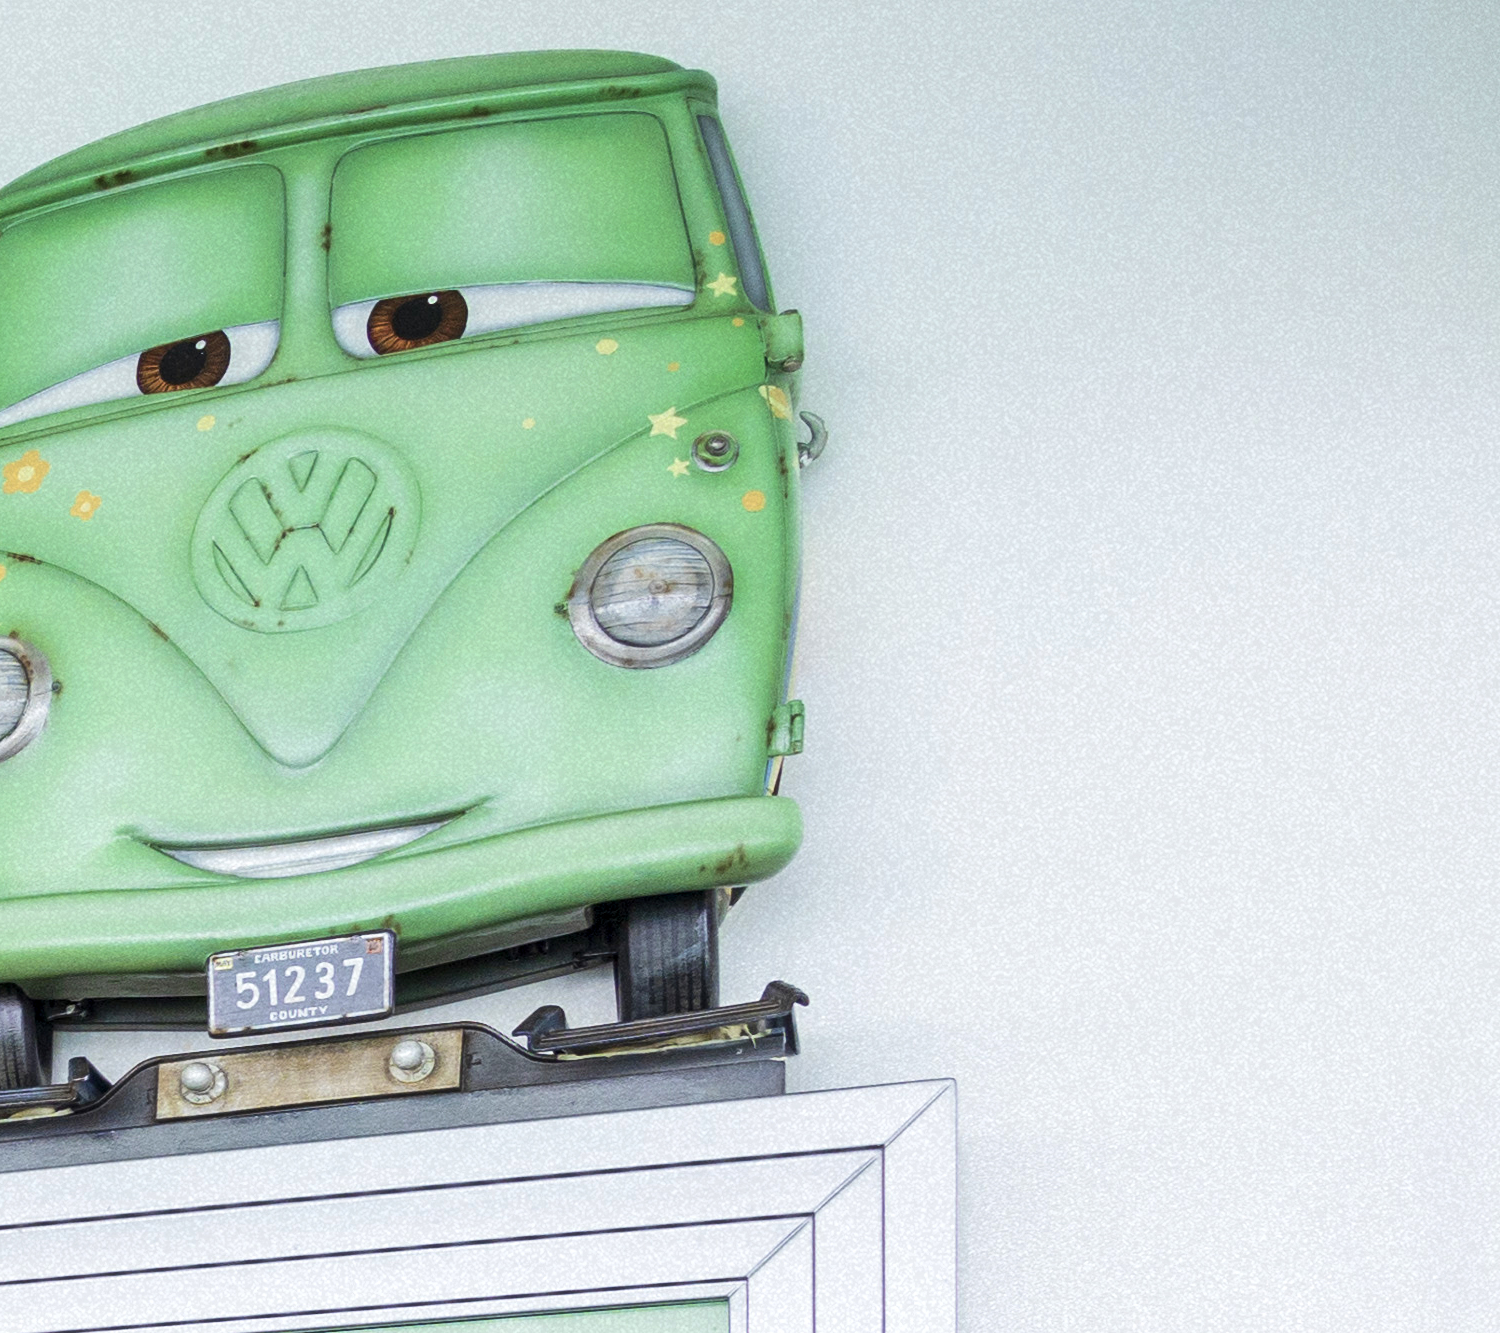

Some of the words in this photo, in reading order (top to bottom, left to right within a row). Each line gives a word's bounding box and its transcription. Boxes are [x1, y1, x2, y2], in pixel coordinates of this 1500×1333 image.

[254, 944, 339, 964] CARBURETOR
[235, 957, 364, 1010] 51237
[269, 1005, 328, 1021] COUNTY
